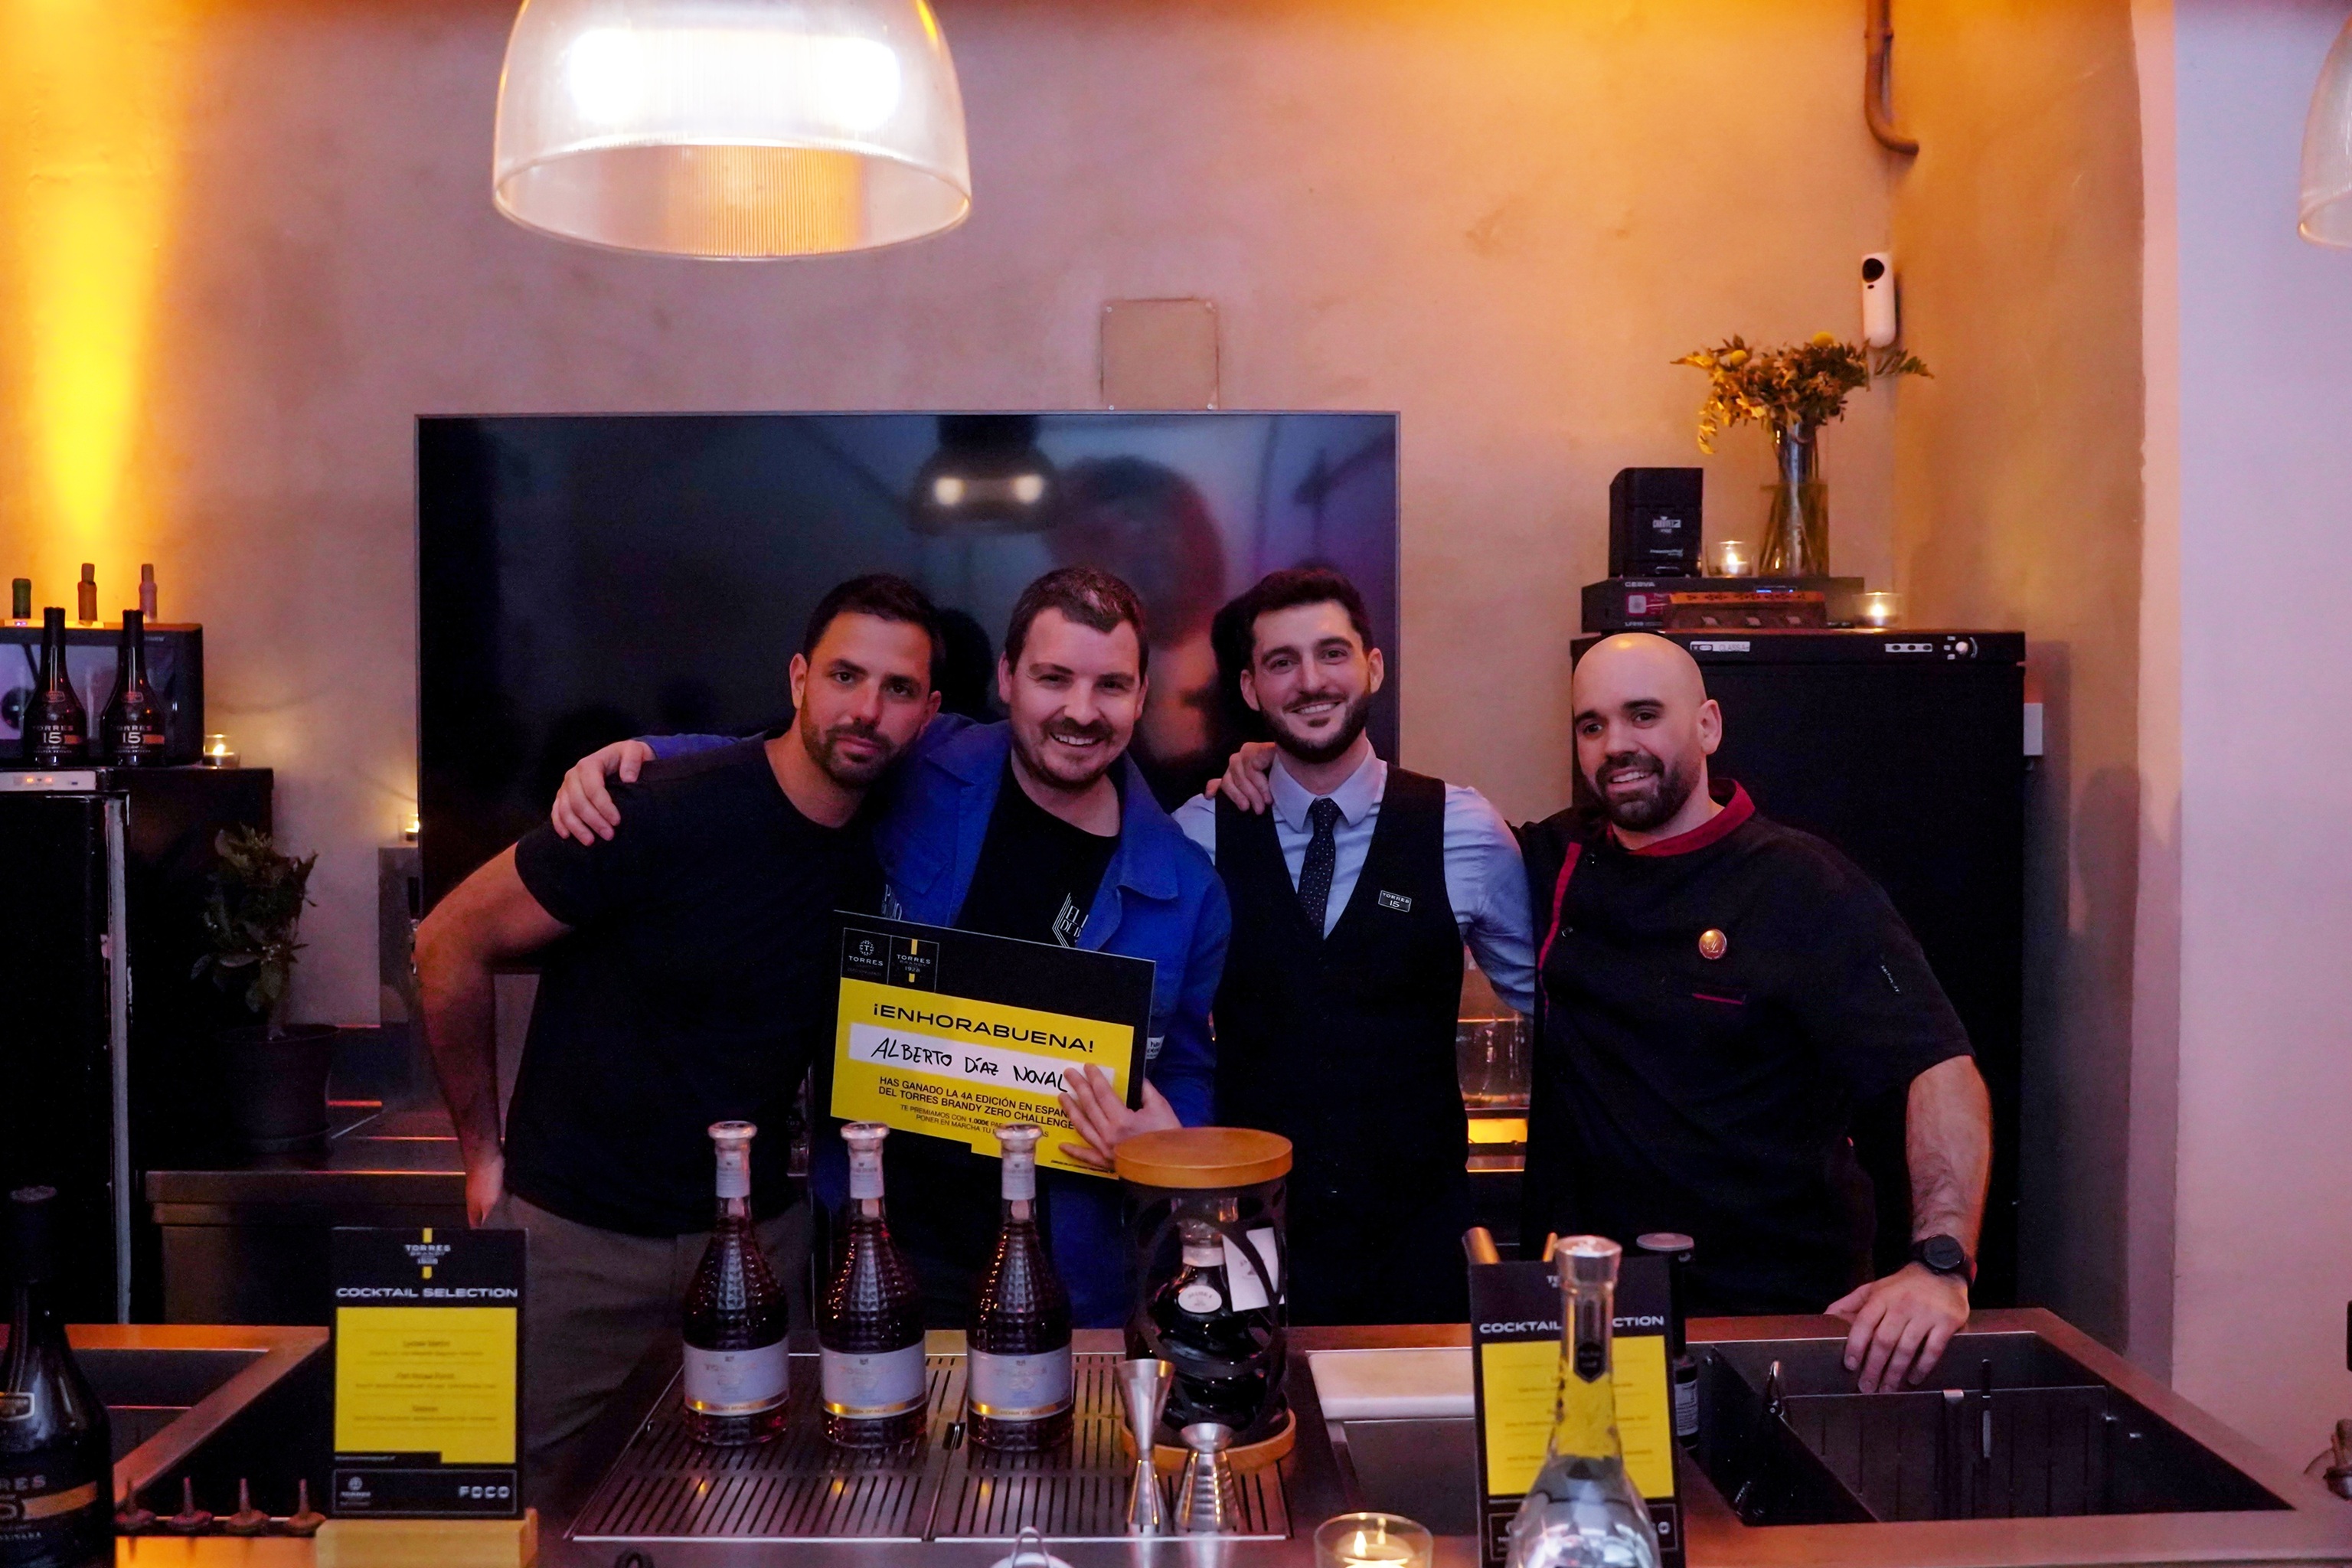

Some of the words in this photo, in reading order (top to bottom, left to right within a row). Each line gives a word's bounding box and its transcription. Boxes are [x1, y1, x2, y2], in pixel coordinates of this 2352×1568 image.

[43, 731, 63, 744] 15
[122, 731, 142, 744] 15
[1382, 892, 1410, 903] TORRES
[848, 955, 884, 966] TORRES
[897, 953, 931, 965] TORRES
[874, 1003, 1093, 1053] ¡ENHORABUENA!
[871, 1037, 952, 1067] ALBERTO
[1013, 1065, 1068, 1093] NOVAL
[880, 1076, 900, 1087] HAS
[902, 1080, 943, 1095] GANADO
[946, 1088, 958, 1098] LA
[961, 1092, 972, 1100] 4A
[975, 1094, 1016, 1109] EDICIÓN
[1019, 1102, 1032, 1112] EN
[879, 1086, 897, 1097] DEL
[900, 1089, 939, 1105] TORRES
[941, 1097, 982, 1112] BRANDY
[985, 1106, 1011, 1118] ZERO
[1014, 1111, 1074, 1129] CHALLENGE
[910, 1106, 950, 1119] PREMIAMOS
[952, 1114, 966, 1122] CON
[969, 1117, 989, 1126] 1.000€
[916, 1114, 939, 1124] PONER
[952, 1121, 980, 1132] MARCHA
[335, 1288, 420, 1298] COCKTAIL
[423, 1288, 518, 1298] SELECTION
[1479, 1321, 1563, 1334] COCKTAIL
[1612, 1315, 1664, 1328] CTION
[0, 1475, 46, 1491] RES
[458, 1485, 511, 1499] FOCO
